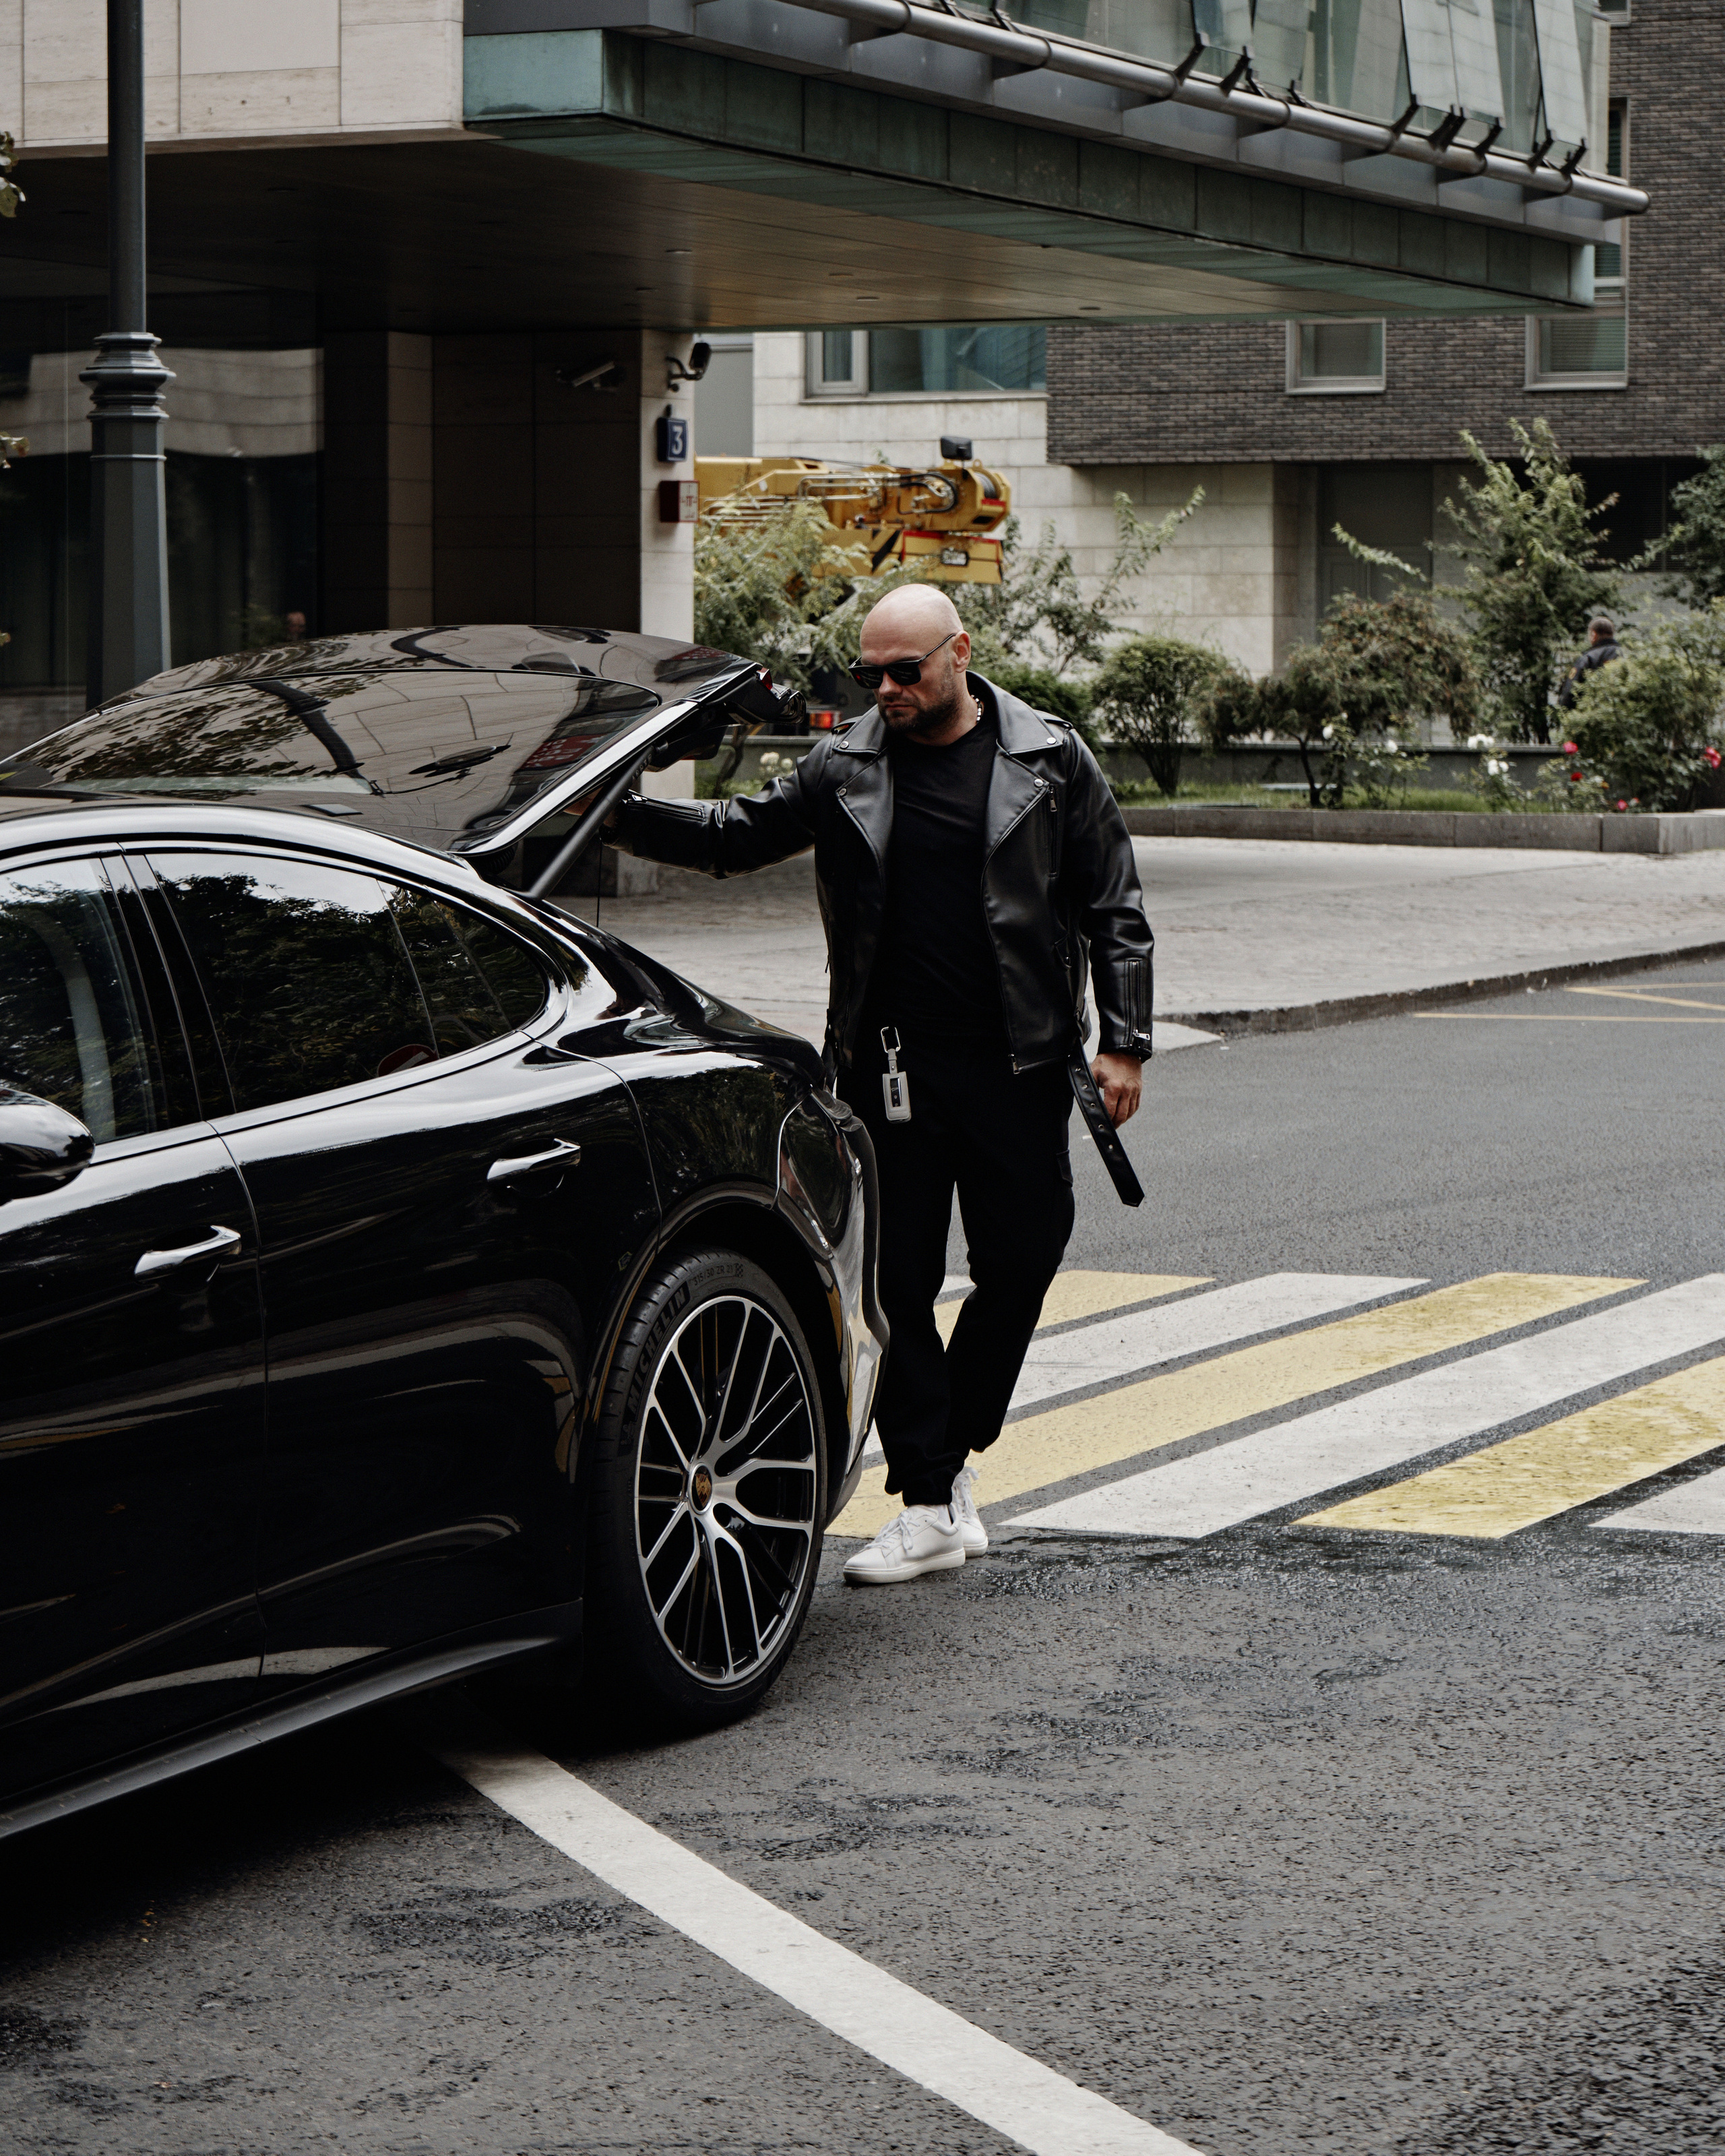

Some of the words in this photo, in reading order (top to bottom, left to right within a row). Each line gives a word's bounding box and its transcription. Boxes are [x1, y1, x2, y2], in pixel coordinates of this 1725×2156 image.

[671, 425, 683, 455] 3
[694, 1268, 715, 1285] 315/30
[716, 1265, 725, 1274] ZR
[726, 1264, 733, 1273] 21
[627, 1285, 687, 1413] MICHELIN
